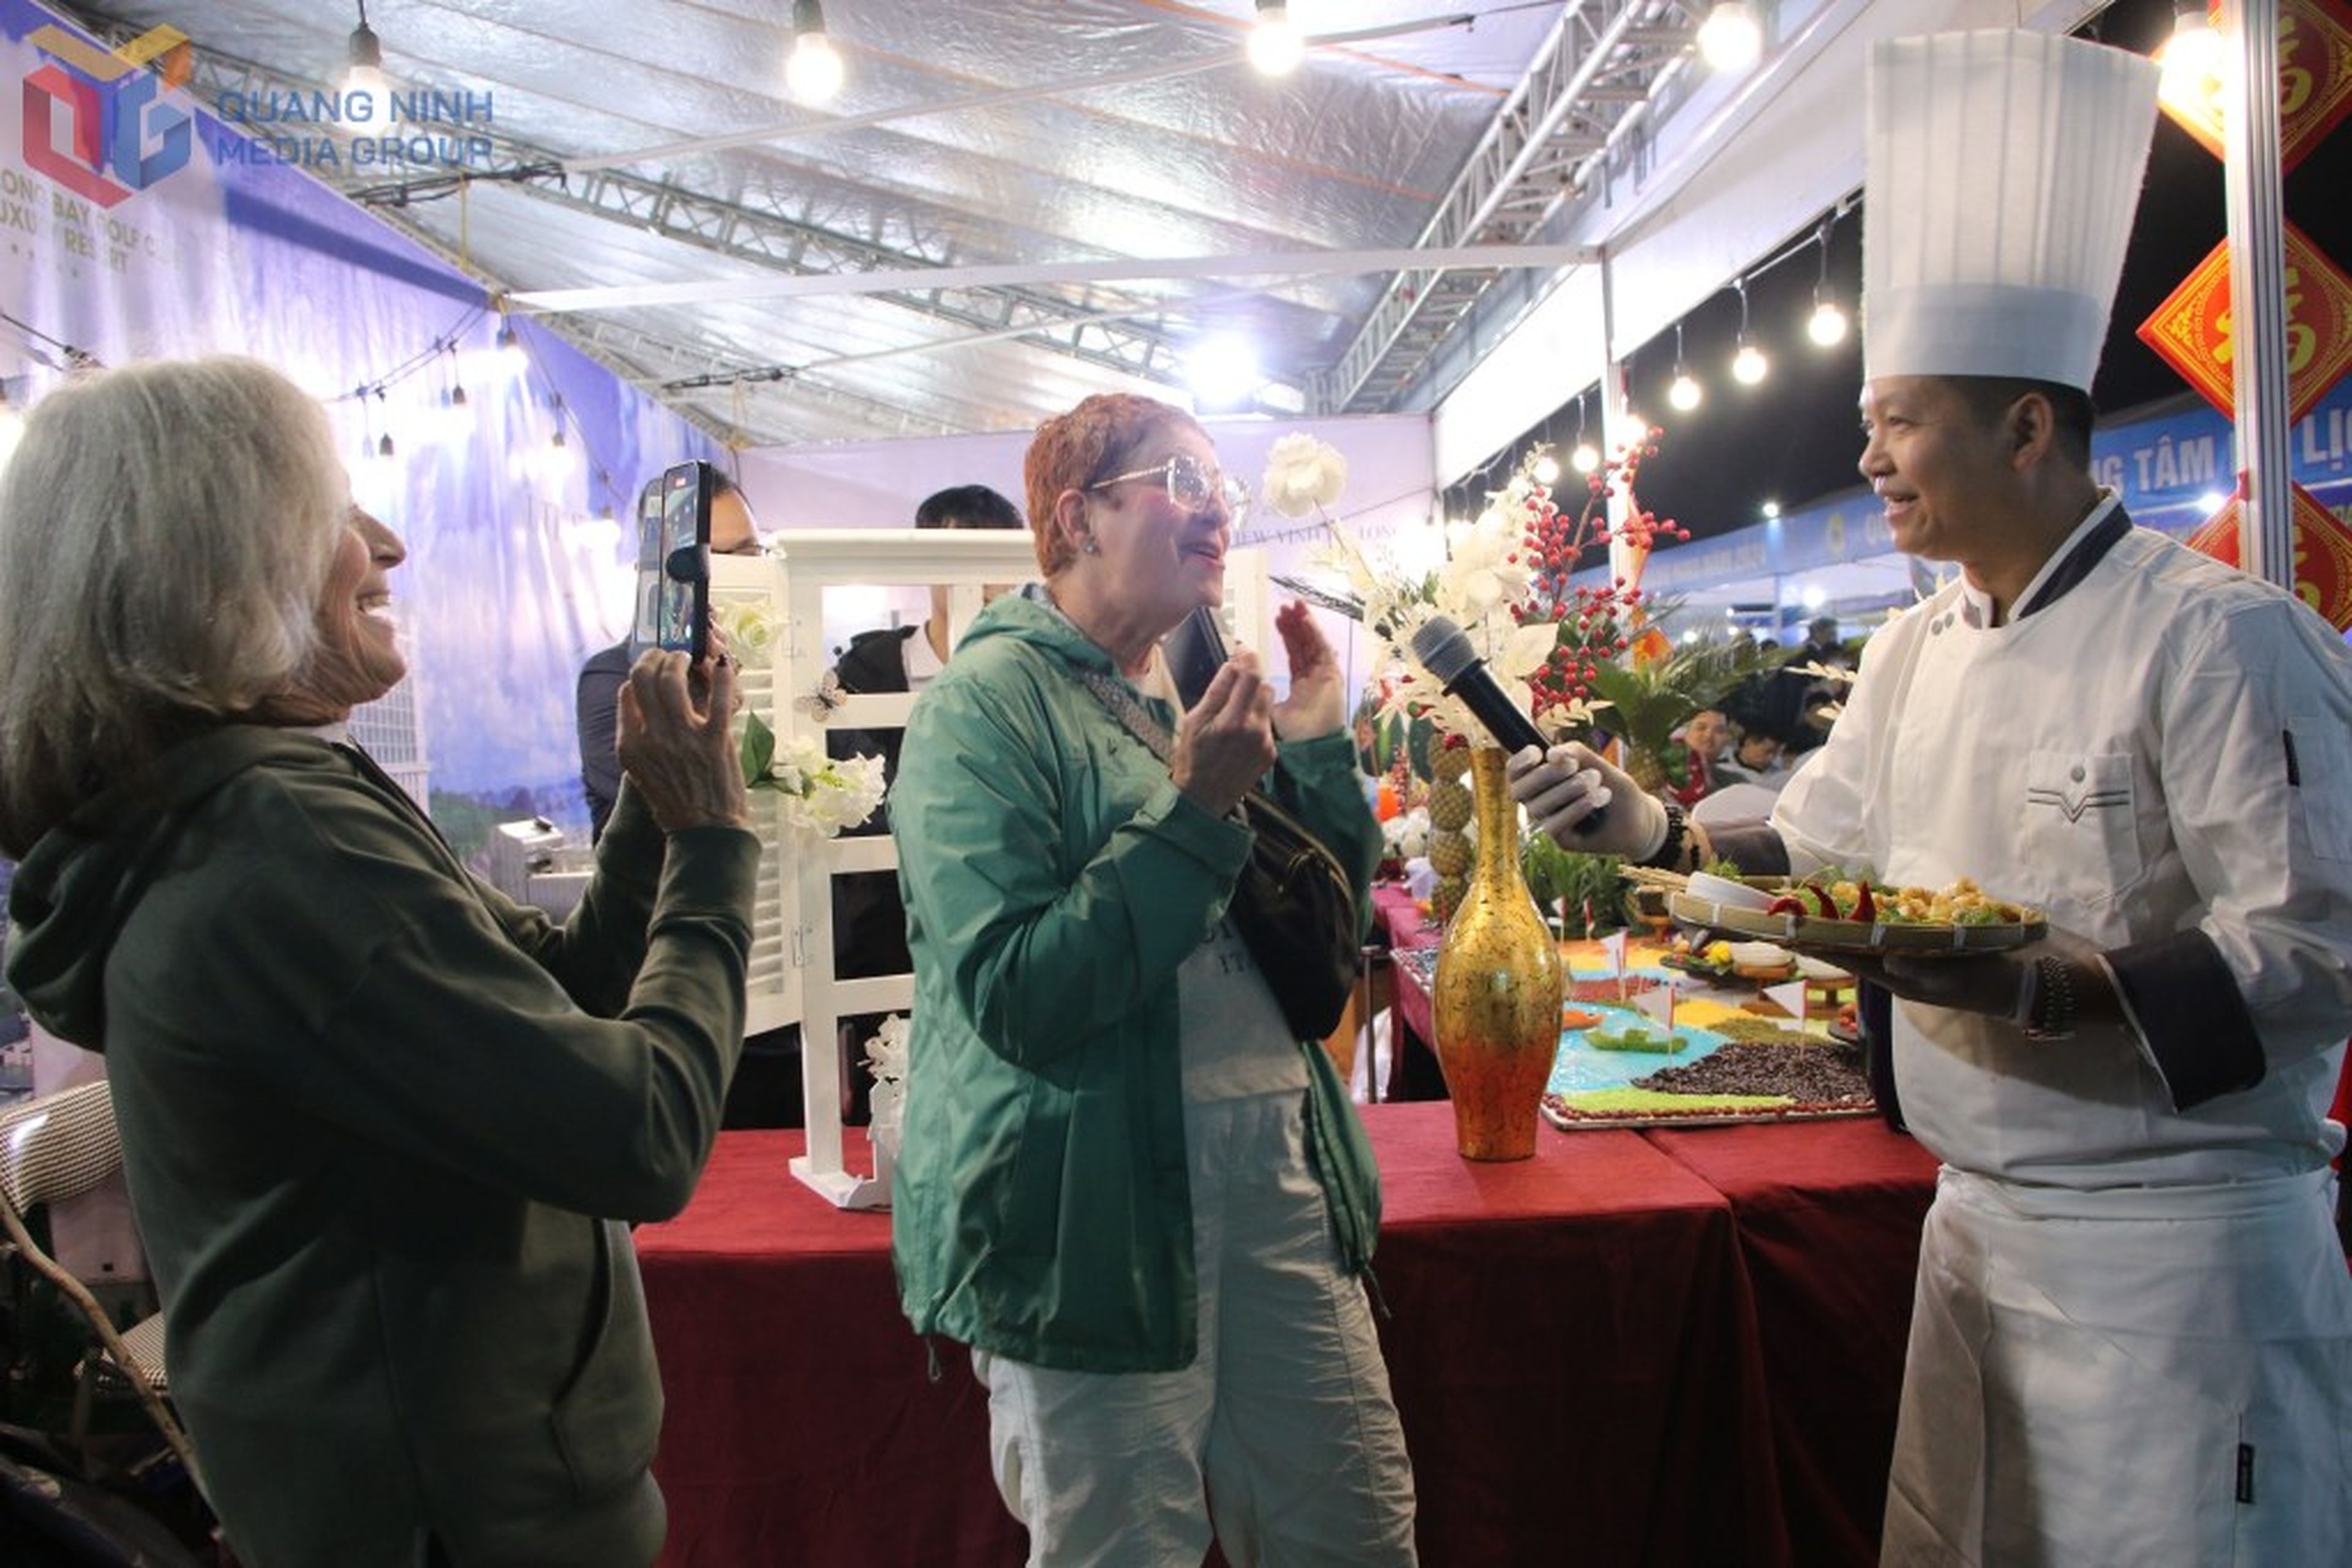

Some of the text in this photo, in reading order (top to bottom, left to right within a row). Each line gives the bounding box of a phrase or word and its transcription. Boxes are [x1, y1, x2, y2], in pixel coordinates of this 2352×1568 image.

[53, 192, 91, 228] BAY
[2133, 434, 2215, 492] TÂM
[2302, 409, 2352, 471] LỊ
